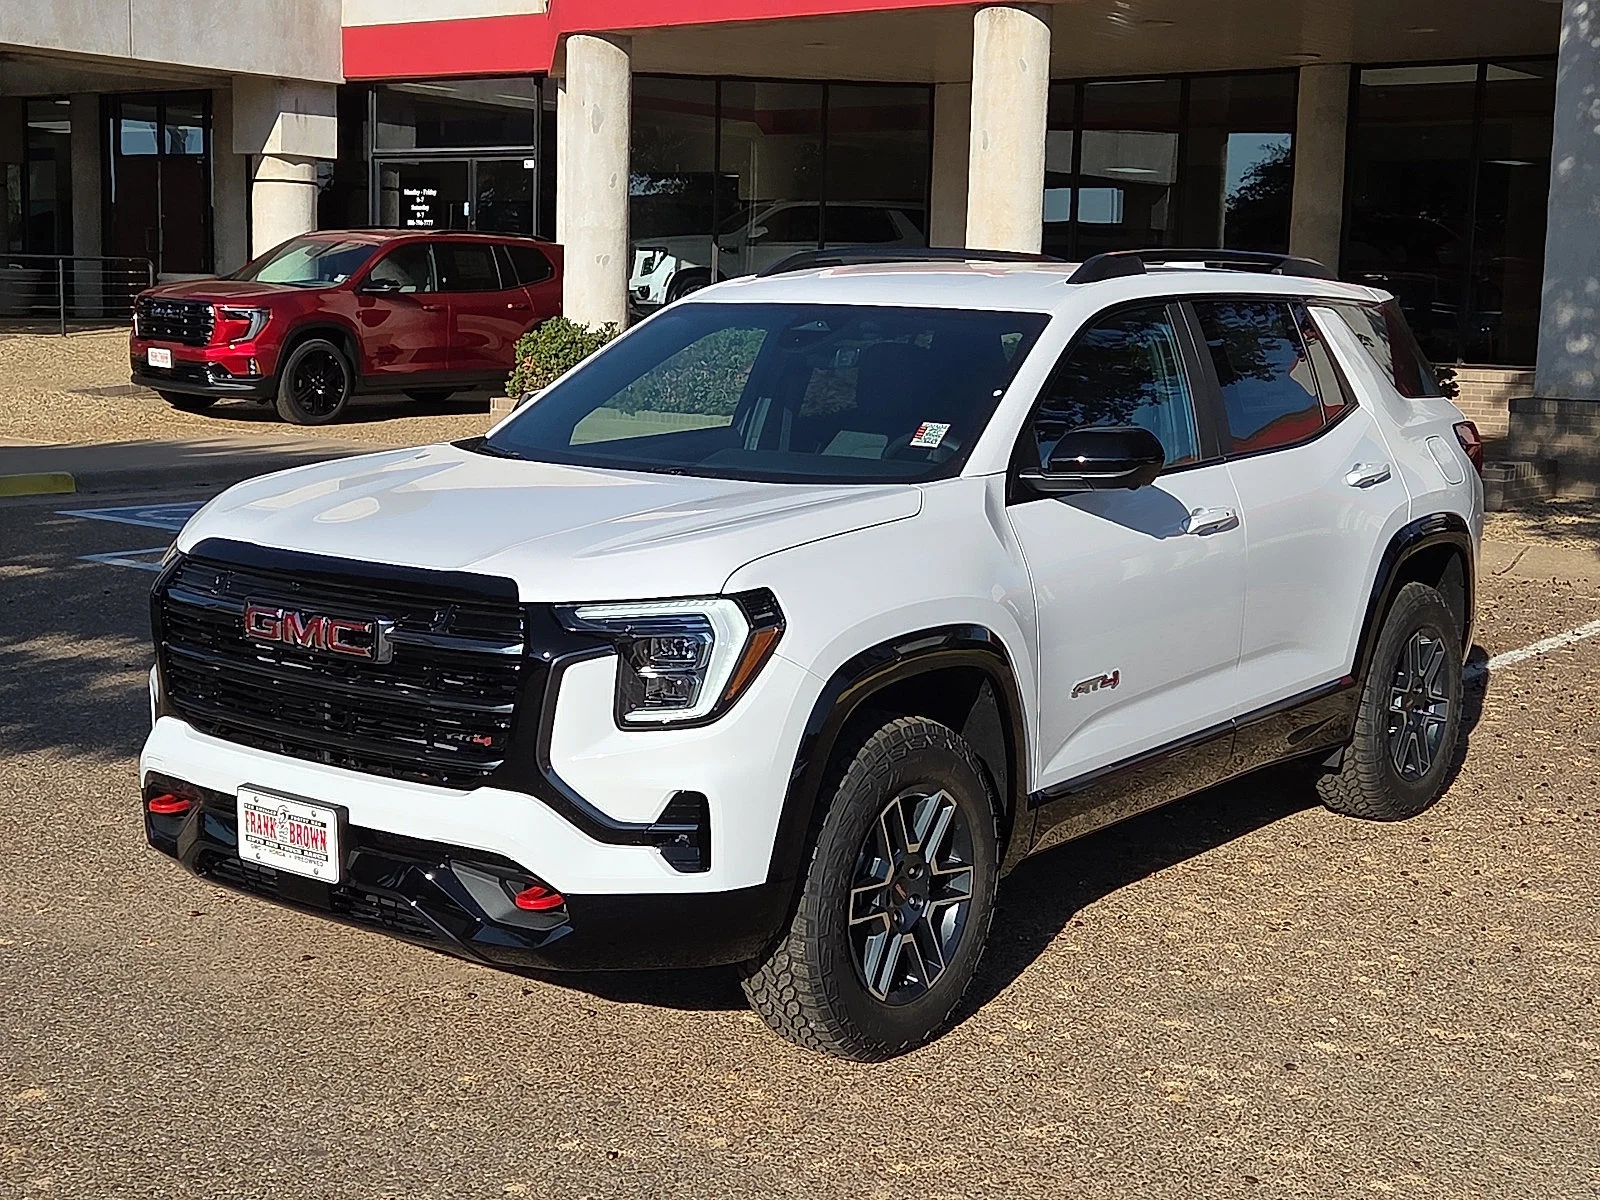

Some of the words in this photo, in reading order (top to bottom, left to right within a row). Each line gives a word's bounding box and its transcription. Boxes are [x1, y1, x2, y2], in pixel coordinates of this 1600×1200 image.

[245, 605, 373, 658] GMC
[1071, 670, 1120, 698] AT4
[244, 810, 277, 840] FRANK
[289, 822, 327, 853] BROWN
